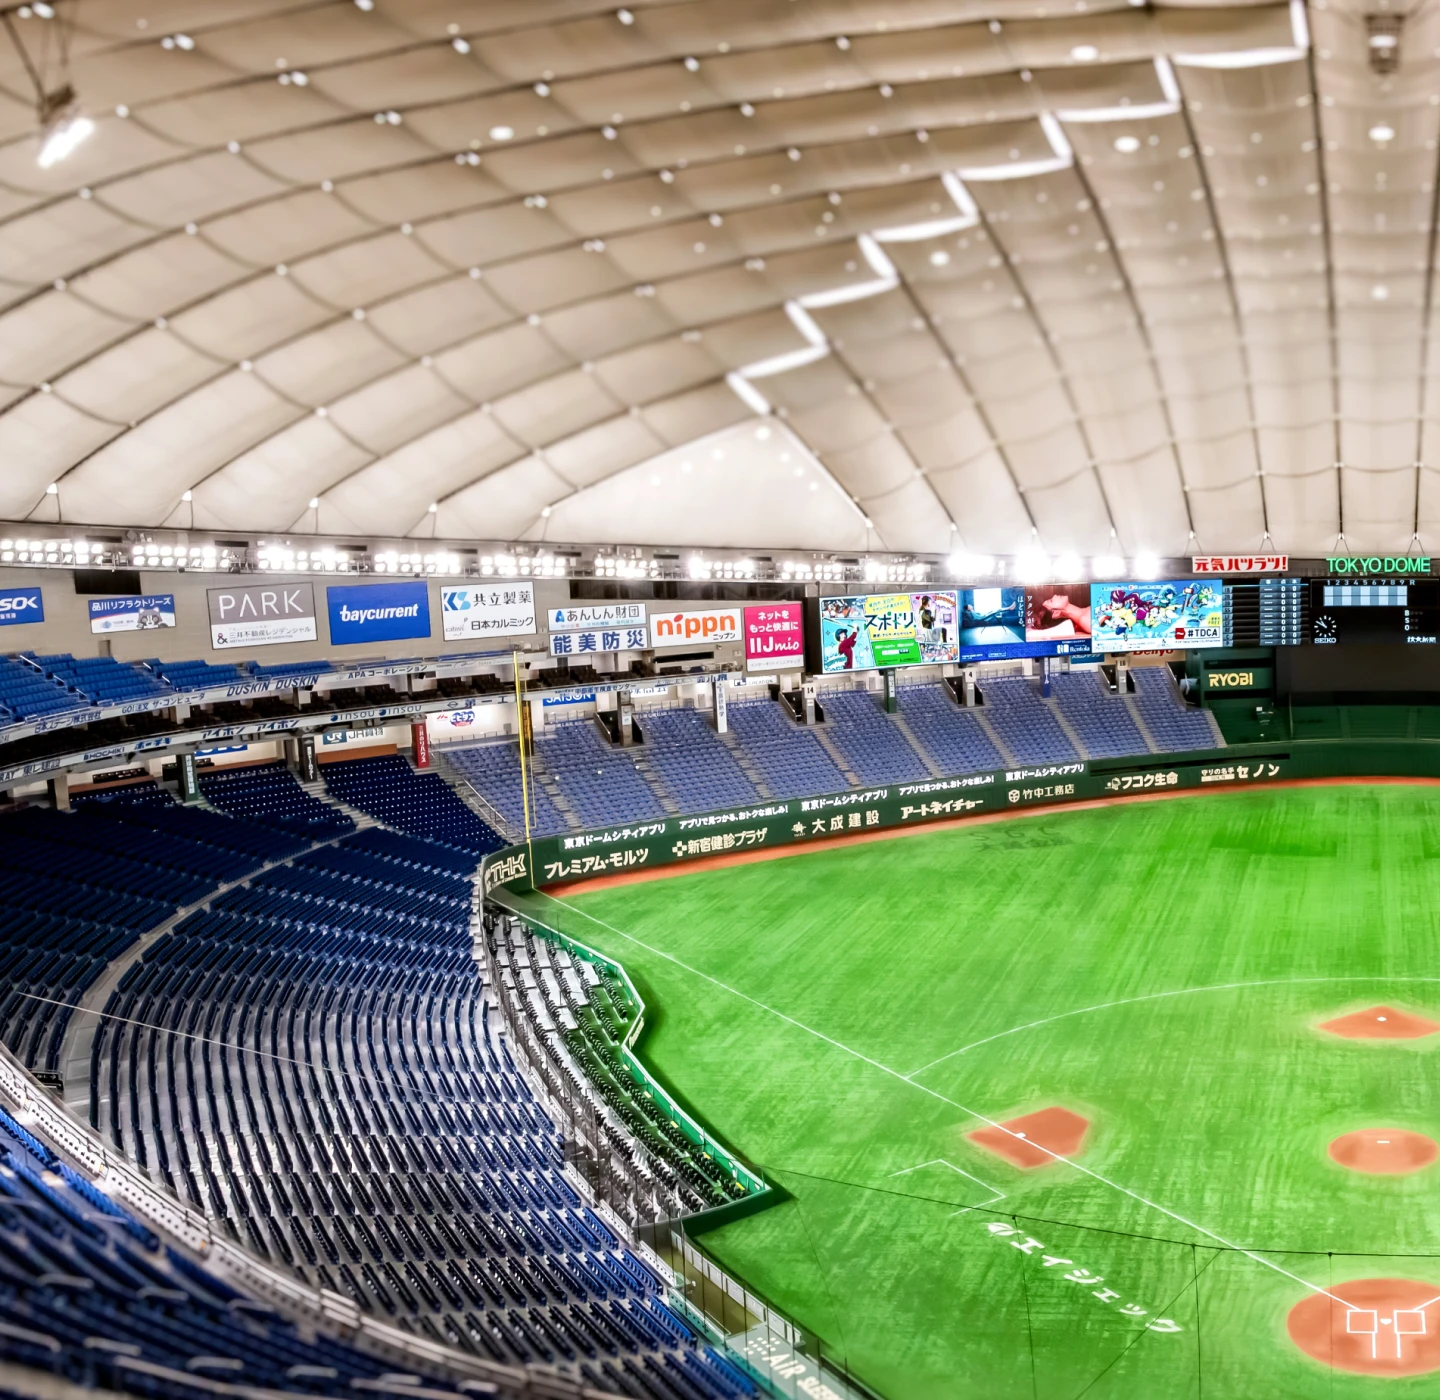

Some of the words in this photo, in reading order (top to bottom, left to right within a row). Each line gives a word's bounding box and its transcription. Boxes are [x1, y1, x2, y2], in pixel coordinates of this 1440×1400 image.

[1195, 556, 1287, 571] 元気ハツラツ!
[1326, 557, 1381, 573] TOKYO
[1384, 557, 1431, 573] DOME
[91, 597, 171, 612] 品川リフラクトリーズ
[218, 590, 304, 619] PARK
[473, 590, 532, 607] 共立製薬
[339, 603, 419, 624] baycurrent
[471, 616, 534, 630] 日本カルミック
[567, 606, 640, 621] あんしん財団
[758, 610, 789, 620] ネットを
[656, 613, 736, 639] nippn
[749, 621, 799, 633] もっと快適に
[1187, 626, 1218, 638] #TDCA
[553, 629, 645, 654] 能美防災
[713, 632, 736, 641] ニップン
[369, 665, 428, 677] コーポレーション
[1209, 673, 1253, 687] RYOBI
[227, 681, 271, 697] DUSKIN
[276, 675, 320, 689] DUSKIN
[1005, 763, 1085, 782] 東京ドームシティアプリ
[1121, 771, 1179, 790] フコク生命
[1237, 763, 1280, 779] セノン
[801, 789, 888, 811] 東京ドームシティアプリ
[1022, 784, 1075, 800] 竹中工務店
[900, 799, 984, 819] アートネイチャー
[812, 810, 880, 834] 大成建設
[564, 823, 666, 849] 東京ドームシティアプリ
[688, 827, 768, 854] 新宿健診プラザ
[490, 853, 526, 882] THK
[544, 848, 649, 880] プレミアム・モルツ
[1009, 1236, 1184, 1332] エイジェック
